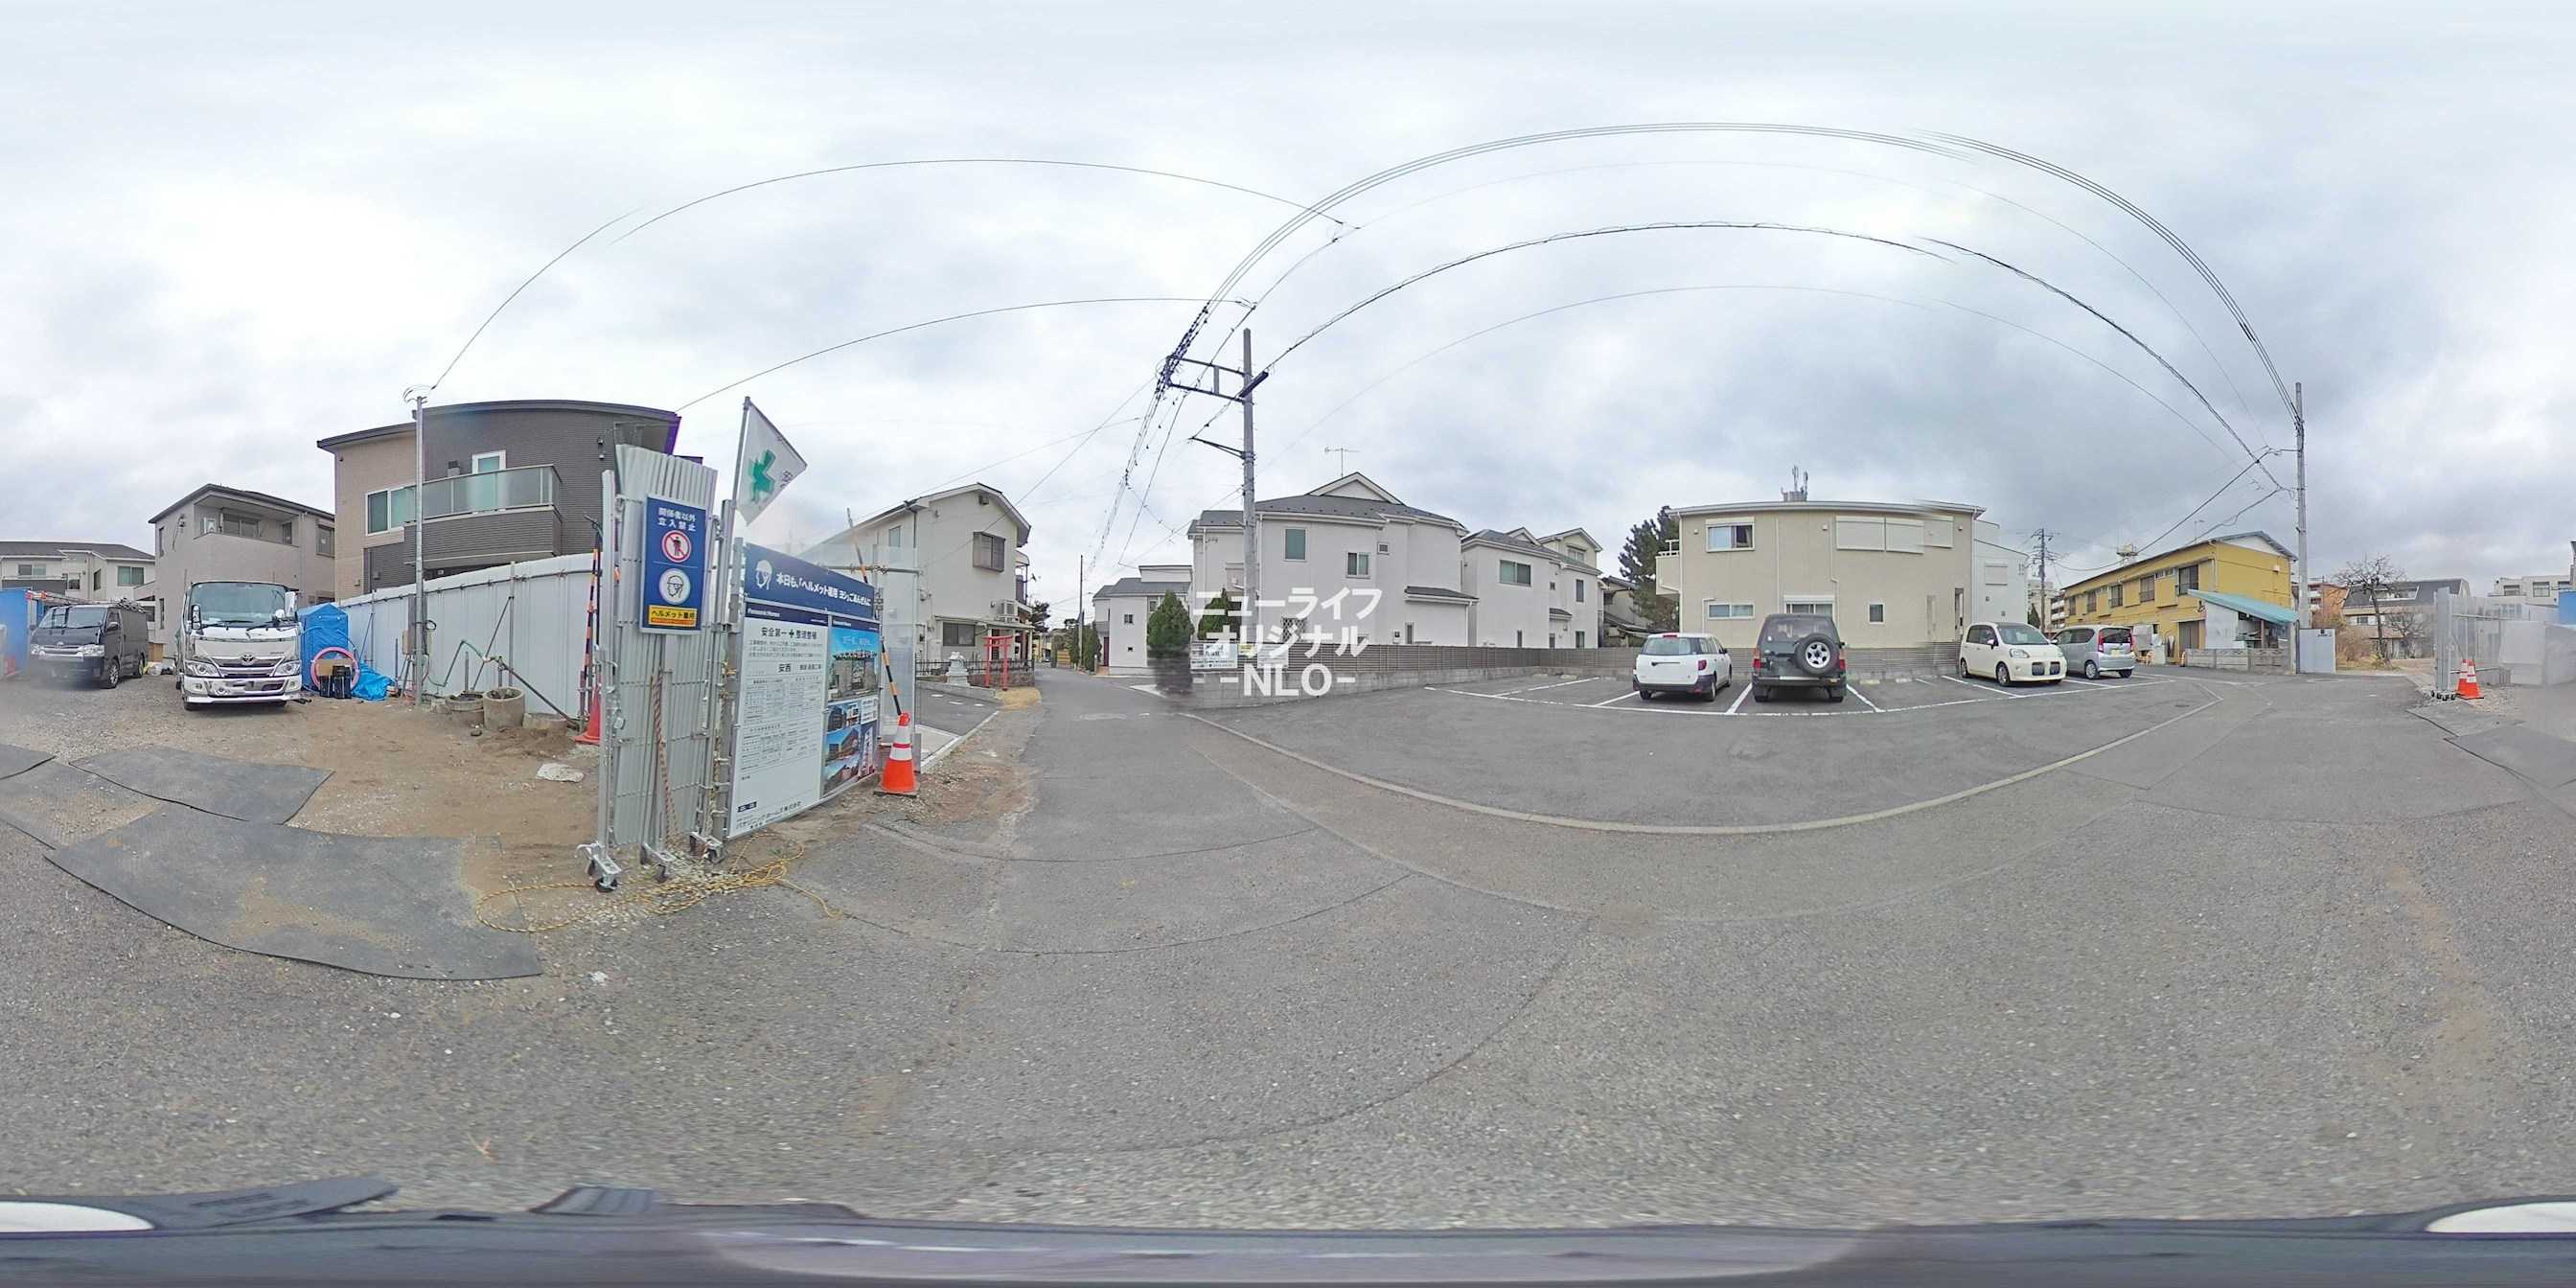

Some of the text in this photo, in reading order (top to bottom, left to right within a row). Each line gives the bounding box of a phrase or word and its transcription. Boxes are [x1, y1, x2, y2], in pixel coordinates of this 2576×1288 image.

[658, 507, 696, 522] 関係者以外
[657, 517, 697, 532] 立入禁止
